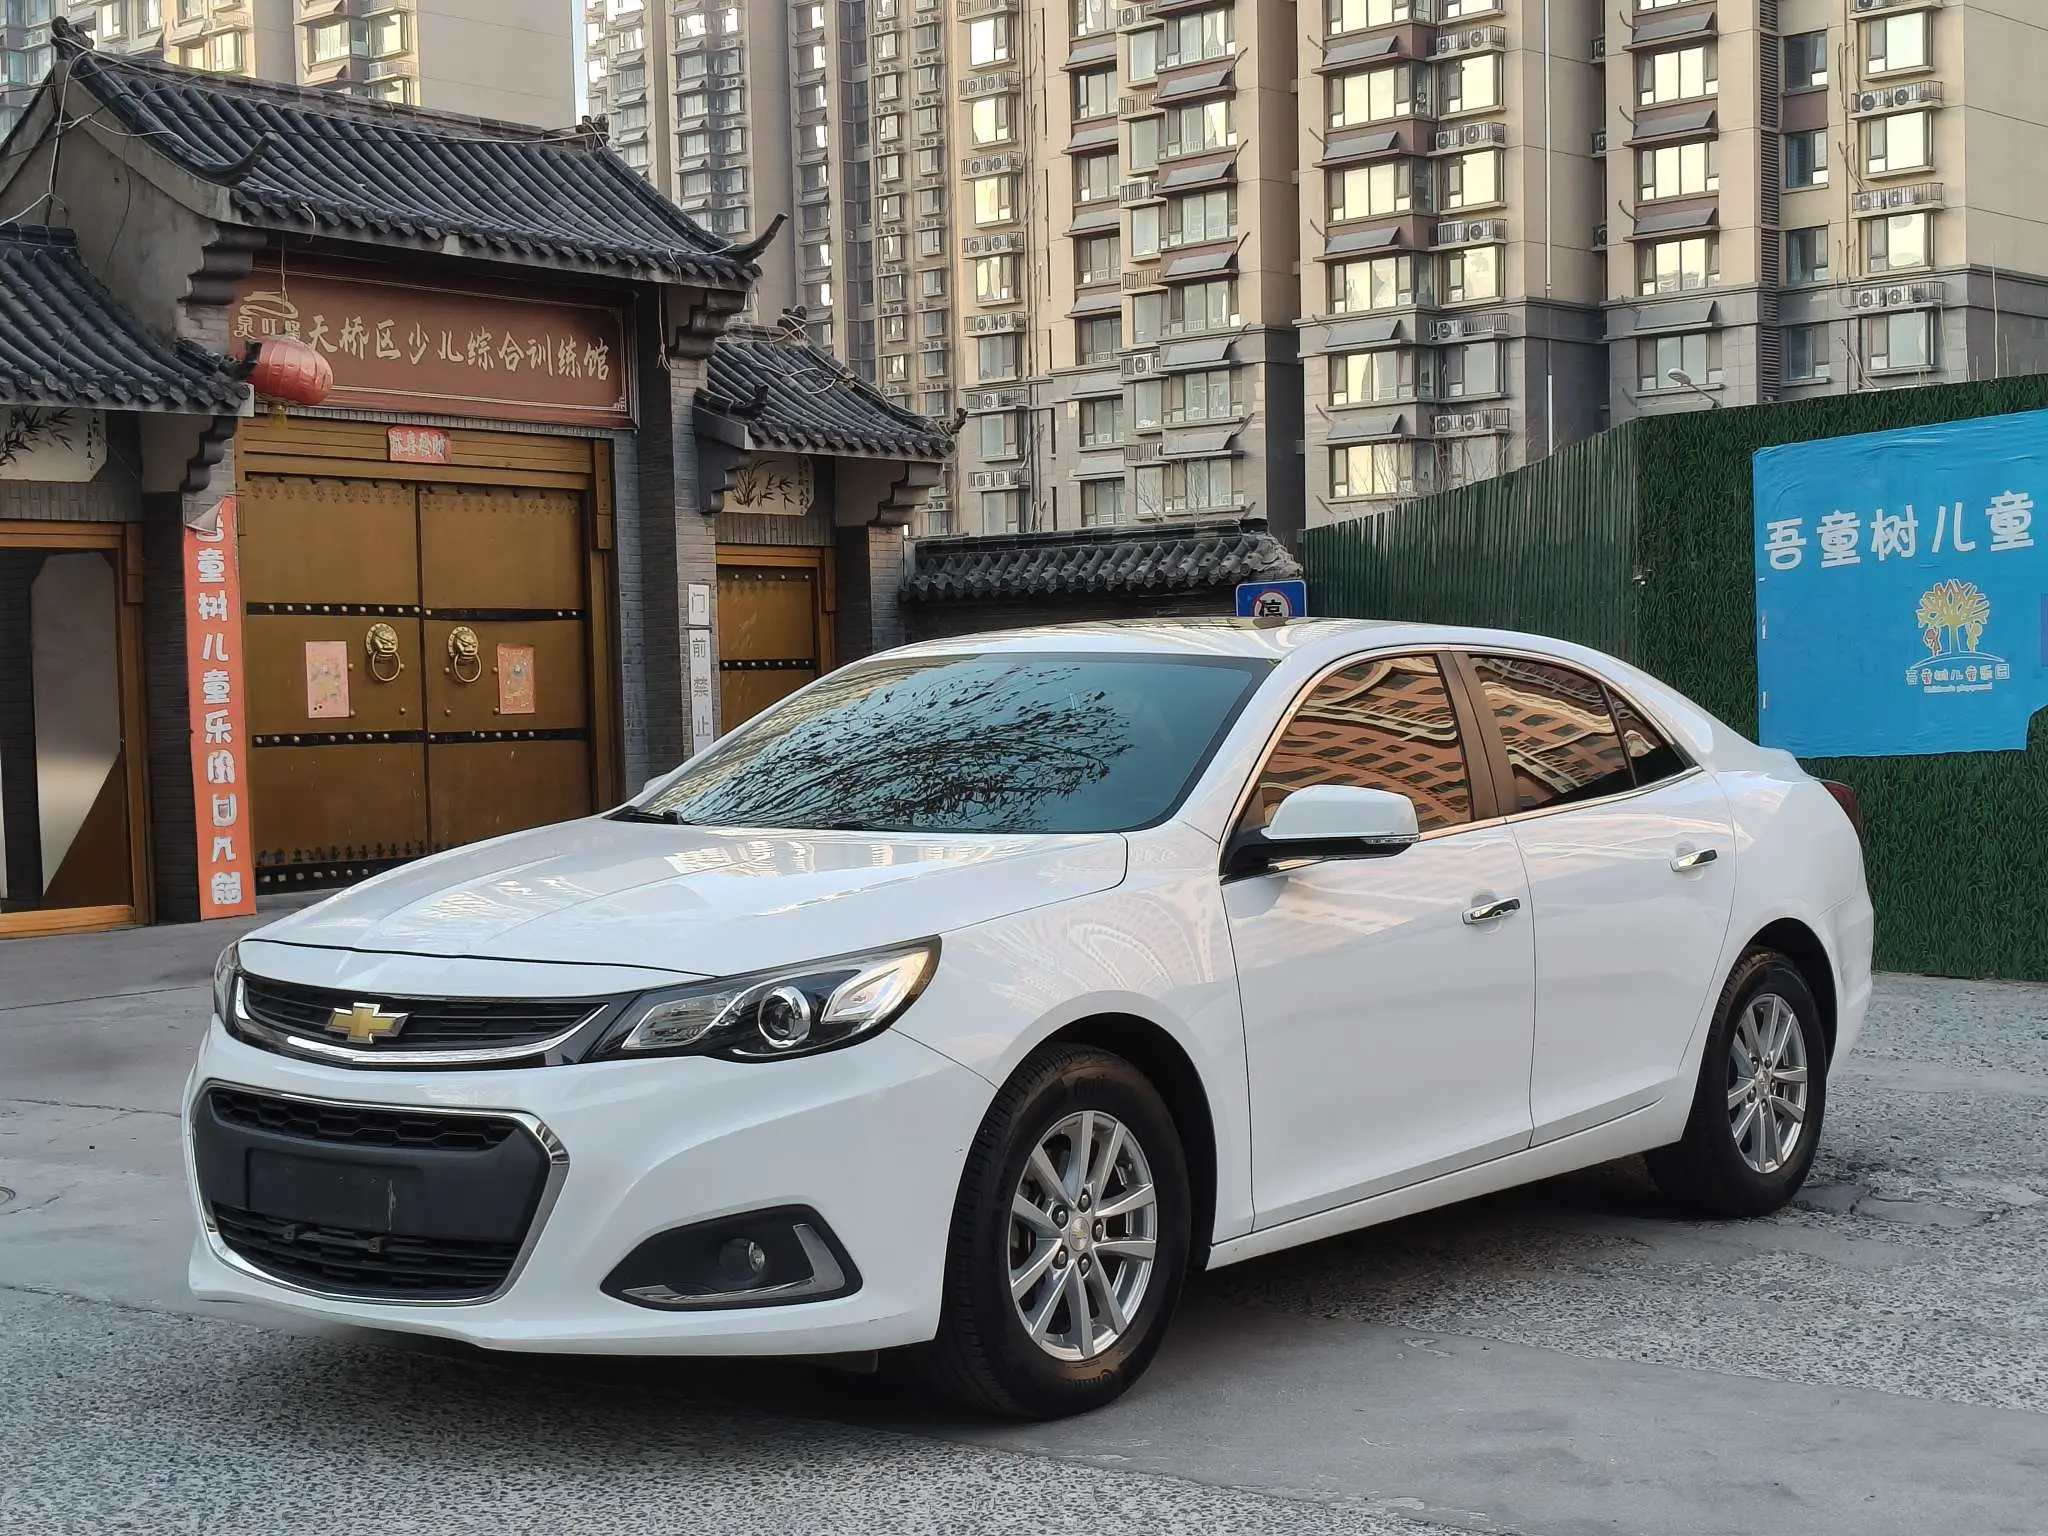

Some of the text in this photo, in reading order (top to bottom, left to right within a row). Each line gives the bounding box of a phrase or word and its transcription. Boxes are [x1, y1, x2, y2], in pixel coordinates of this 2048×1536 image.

[308, 314, 610, 381] 天桥区少儿综合训练馆
[1764, 490, 2035, 570] 吾童树儿童
[691, 592, 711, 737] 门前禁止
